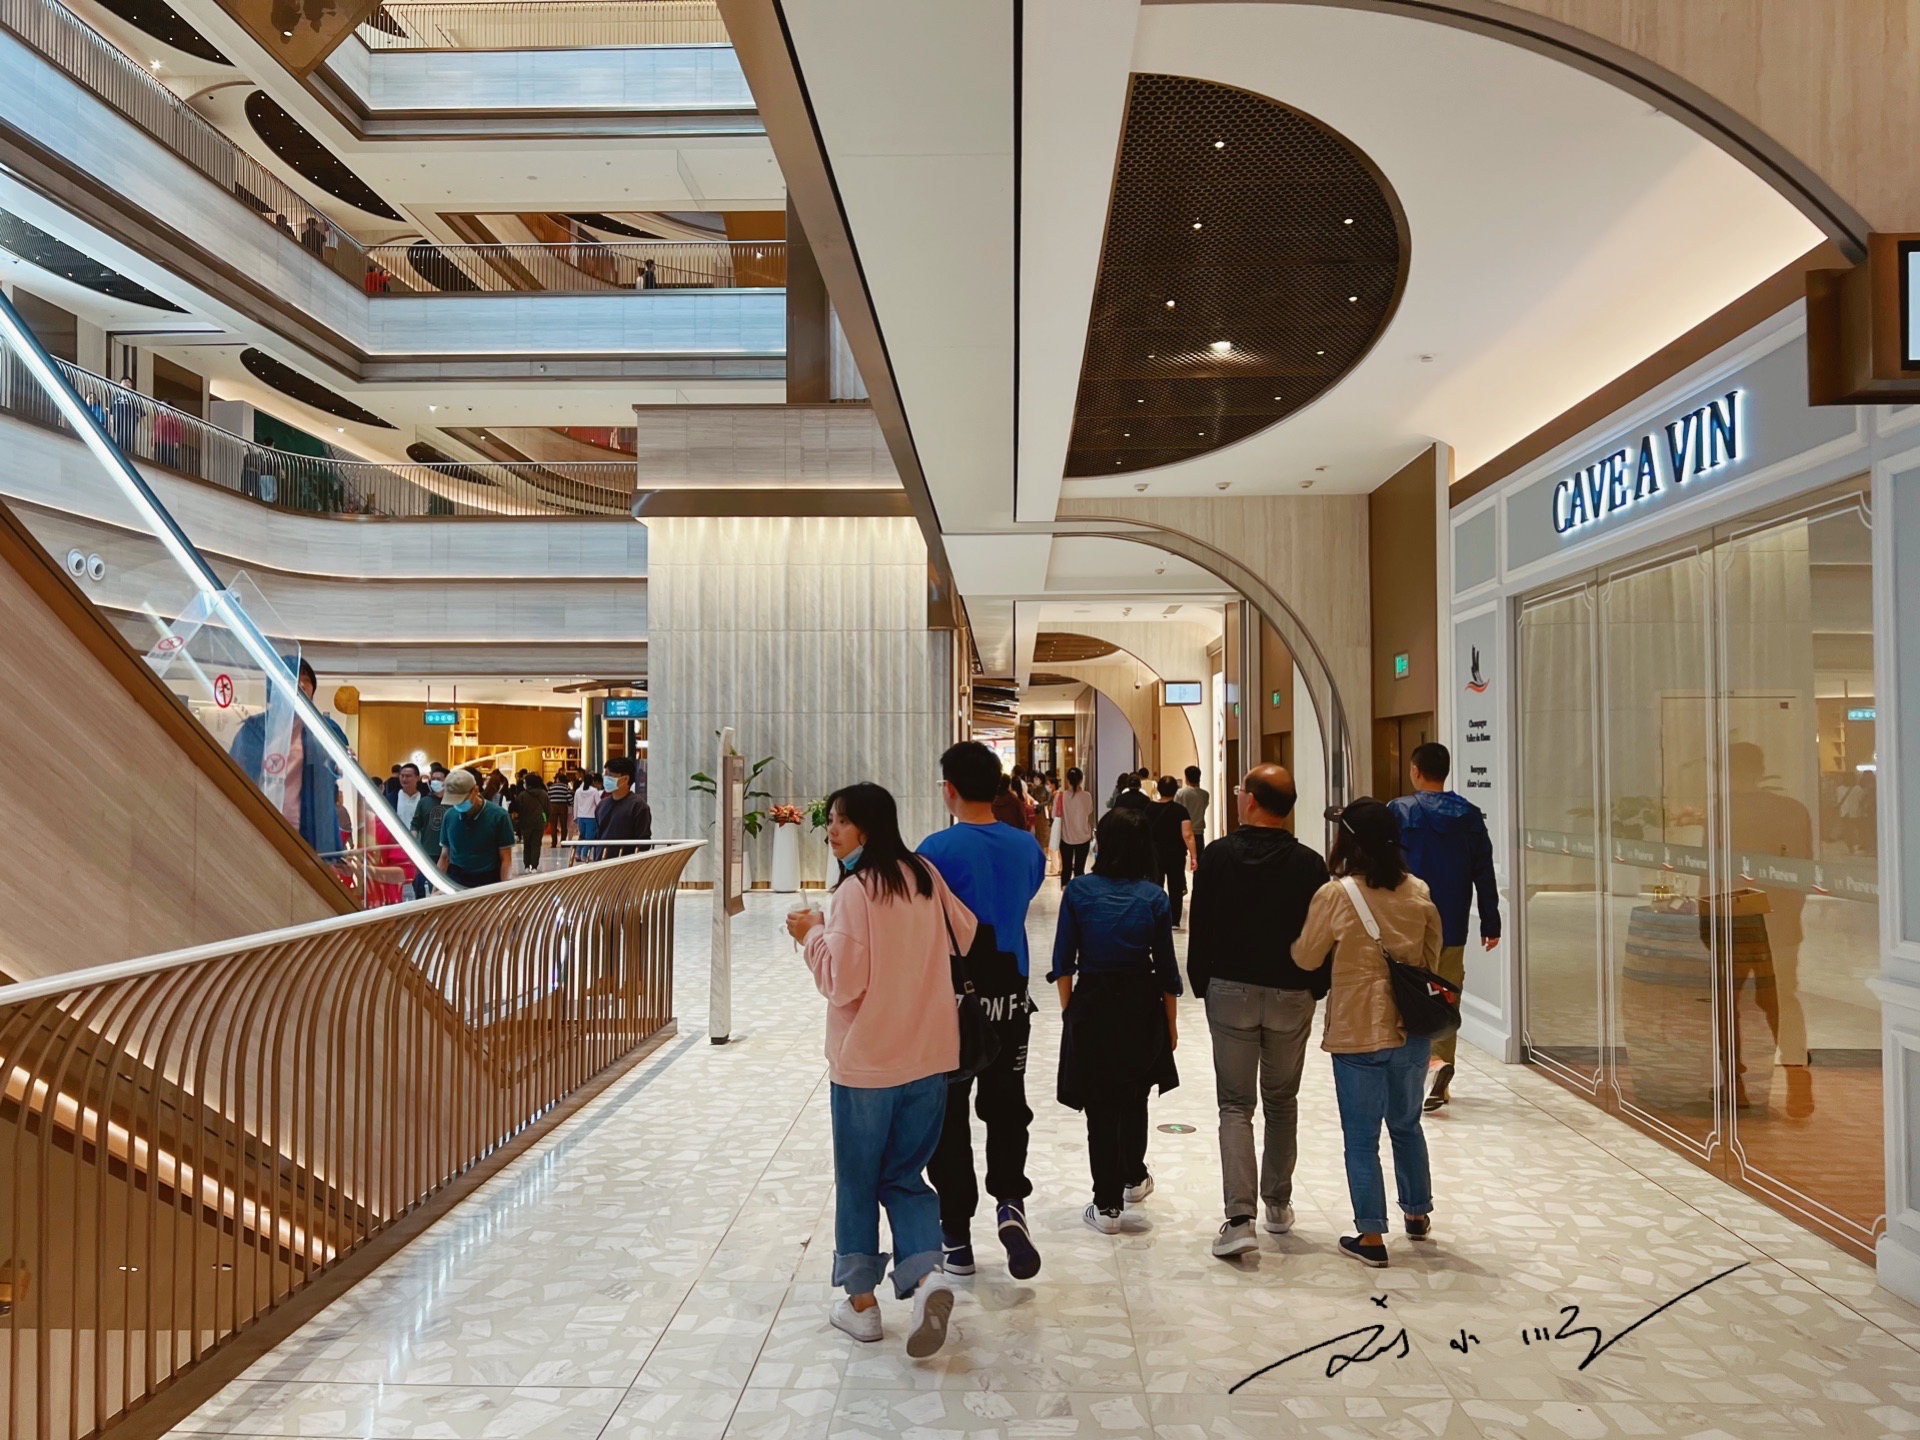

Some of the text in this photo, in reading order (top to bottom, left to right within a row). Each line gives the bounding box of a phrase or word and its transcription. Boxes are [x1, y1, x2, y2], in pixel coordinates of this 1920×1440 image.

[1552, 390, 1740, 534] CAVE A VIN
